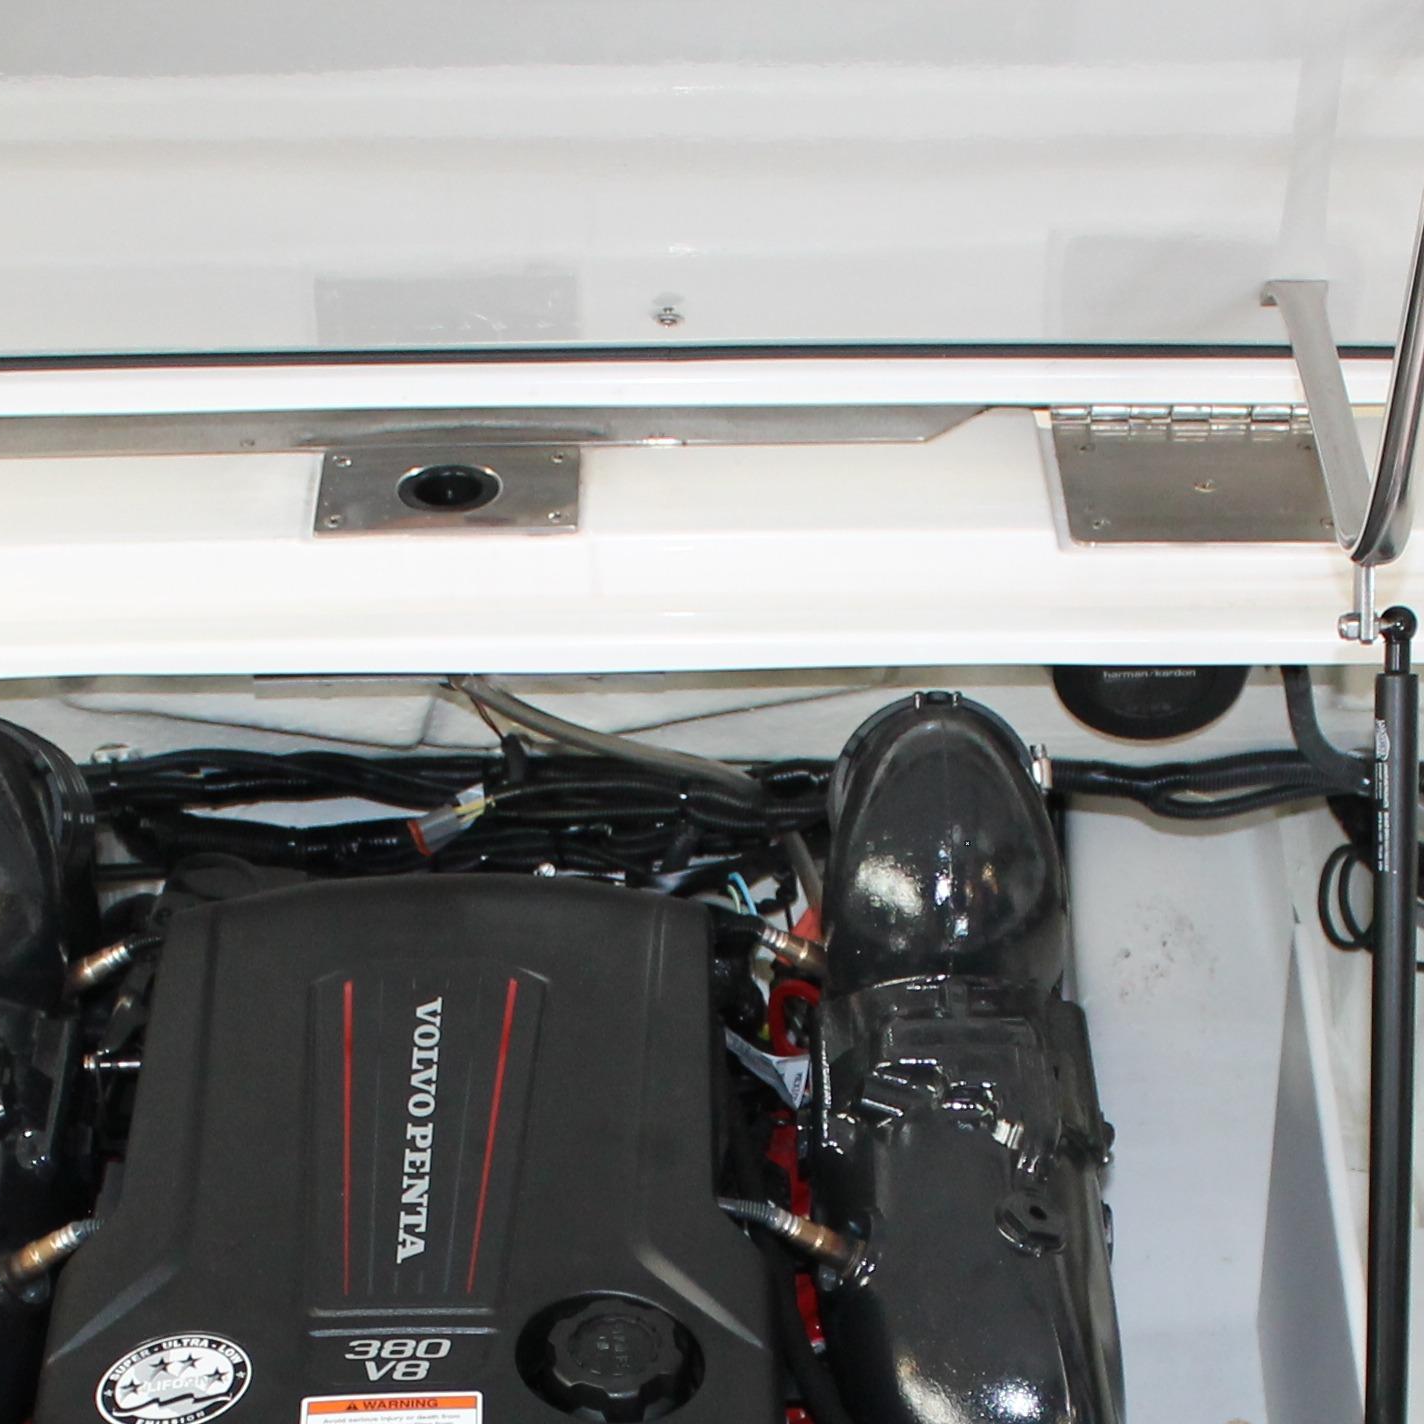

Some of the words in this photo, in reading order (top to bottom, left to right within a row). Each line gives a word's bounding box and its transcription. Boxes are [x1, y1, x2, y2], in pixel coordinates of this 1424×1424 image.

[407, 996, 442, 1118] VOLVO
[396, 1122, 434, 1265] PENTA
[109, 1350, 152, 1381] SUPER
[161, 1338, 209, 1350] ULTRA
[218, 1343, 243, 1364] LOW
[344, 1338, 452, 1360] 380
[364, 1360, 431, 1382] V8
[362, 1399, 438, 1410] WARNING
